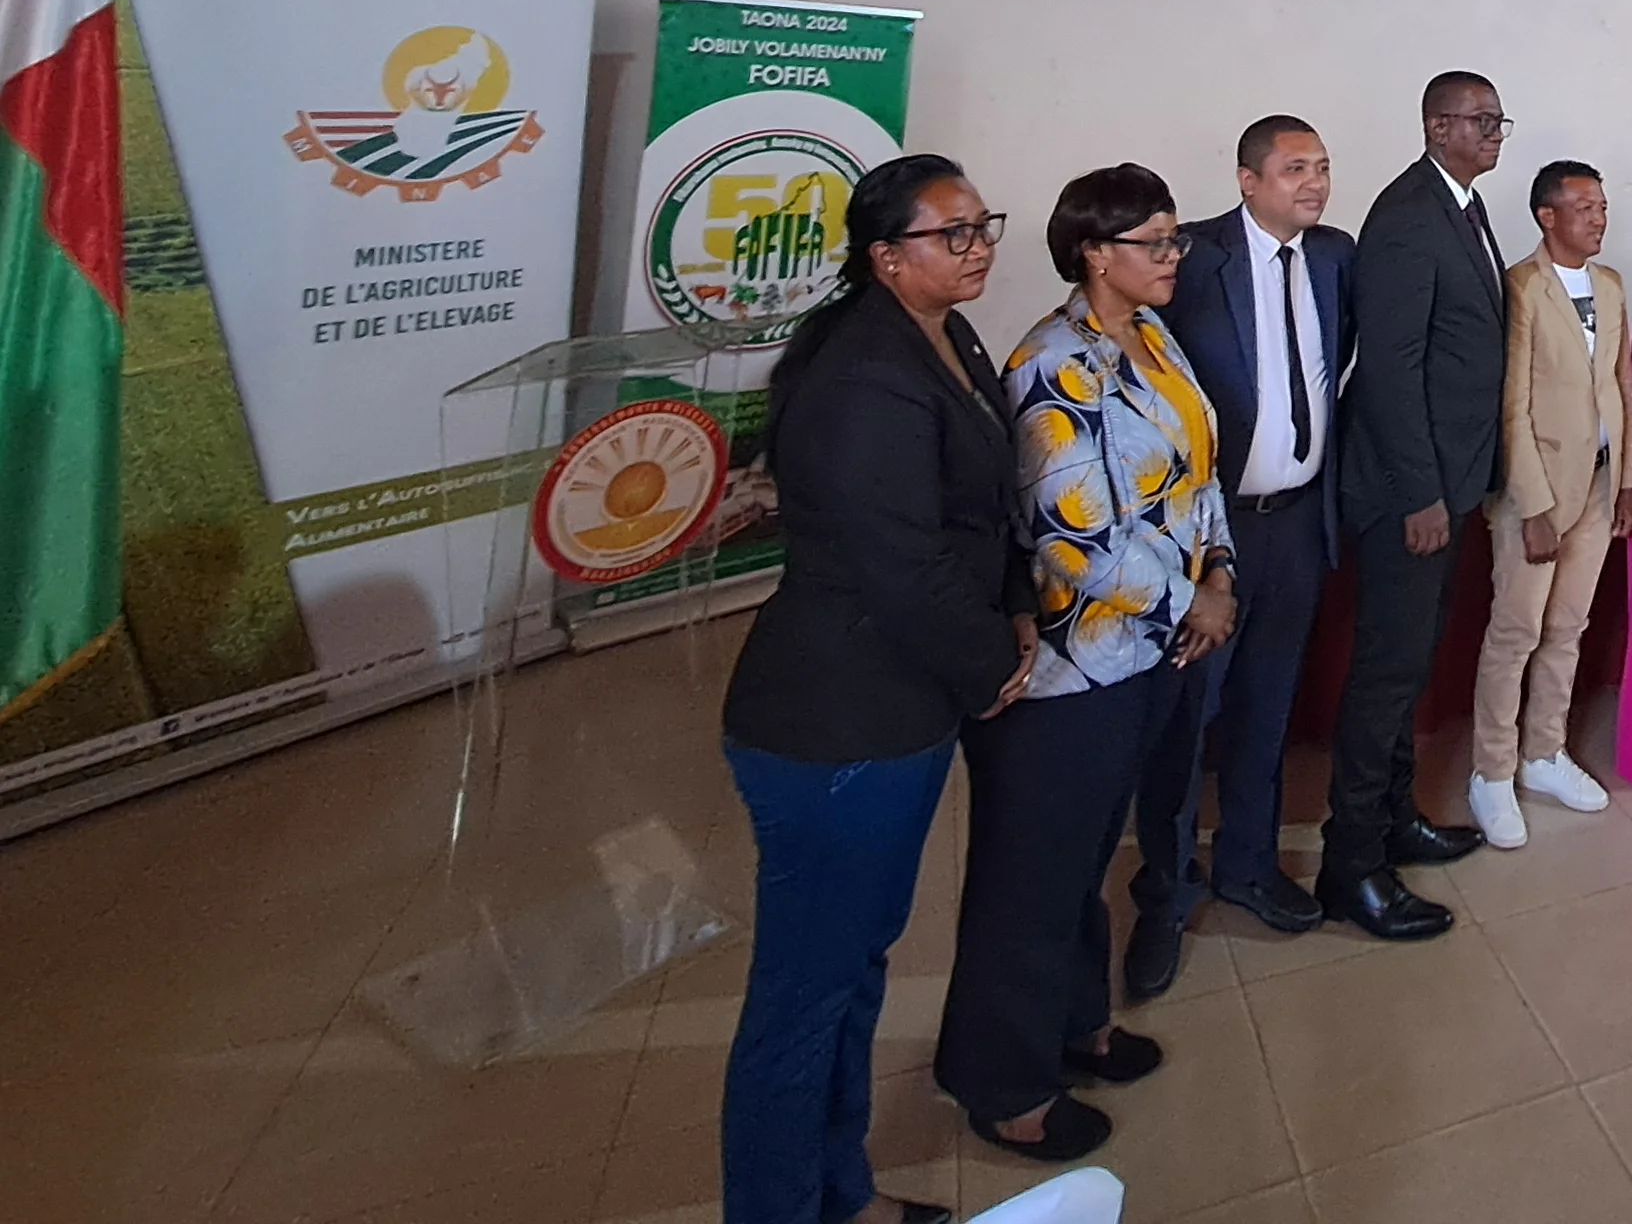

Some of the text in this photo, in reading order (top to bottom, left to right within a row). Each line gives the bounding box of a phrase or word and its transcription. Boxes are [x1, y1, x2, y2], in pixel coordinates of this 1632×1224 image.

[741, 9, 848, 32] TAONA 2024
[687, 36, 888, 62] JOBILY VOLAMENAN'NY
[748, 63, 831, 87] FOFIFA
[354, 238, 485, 267] MINISTERE
[301, 267, 524, 309] DE L'AGRICULTURE
[313, 300, 516, 344] ET DE L'ELEVAGE
